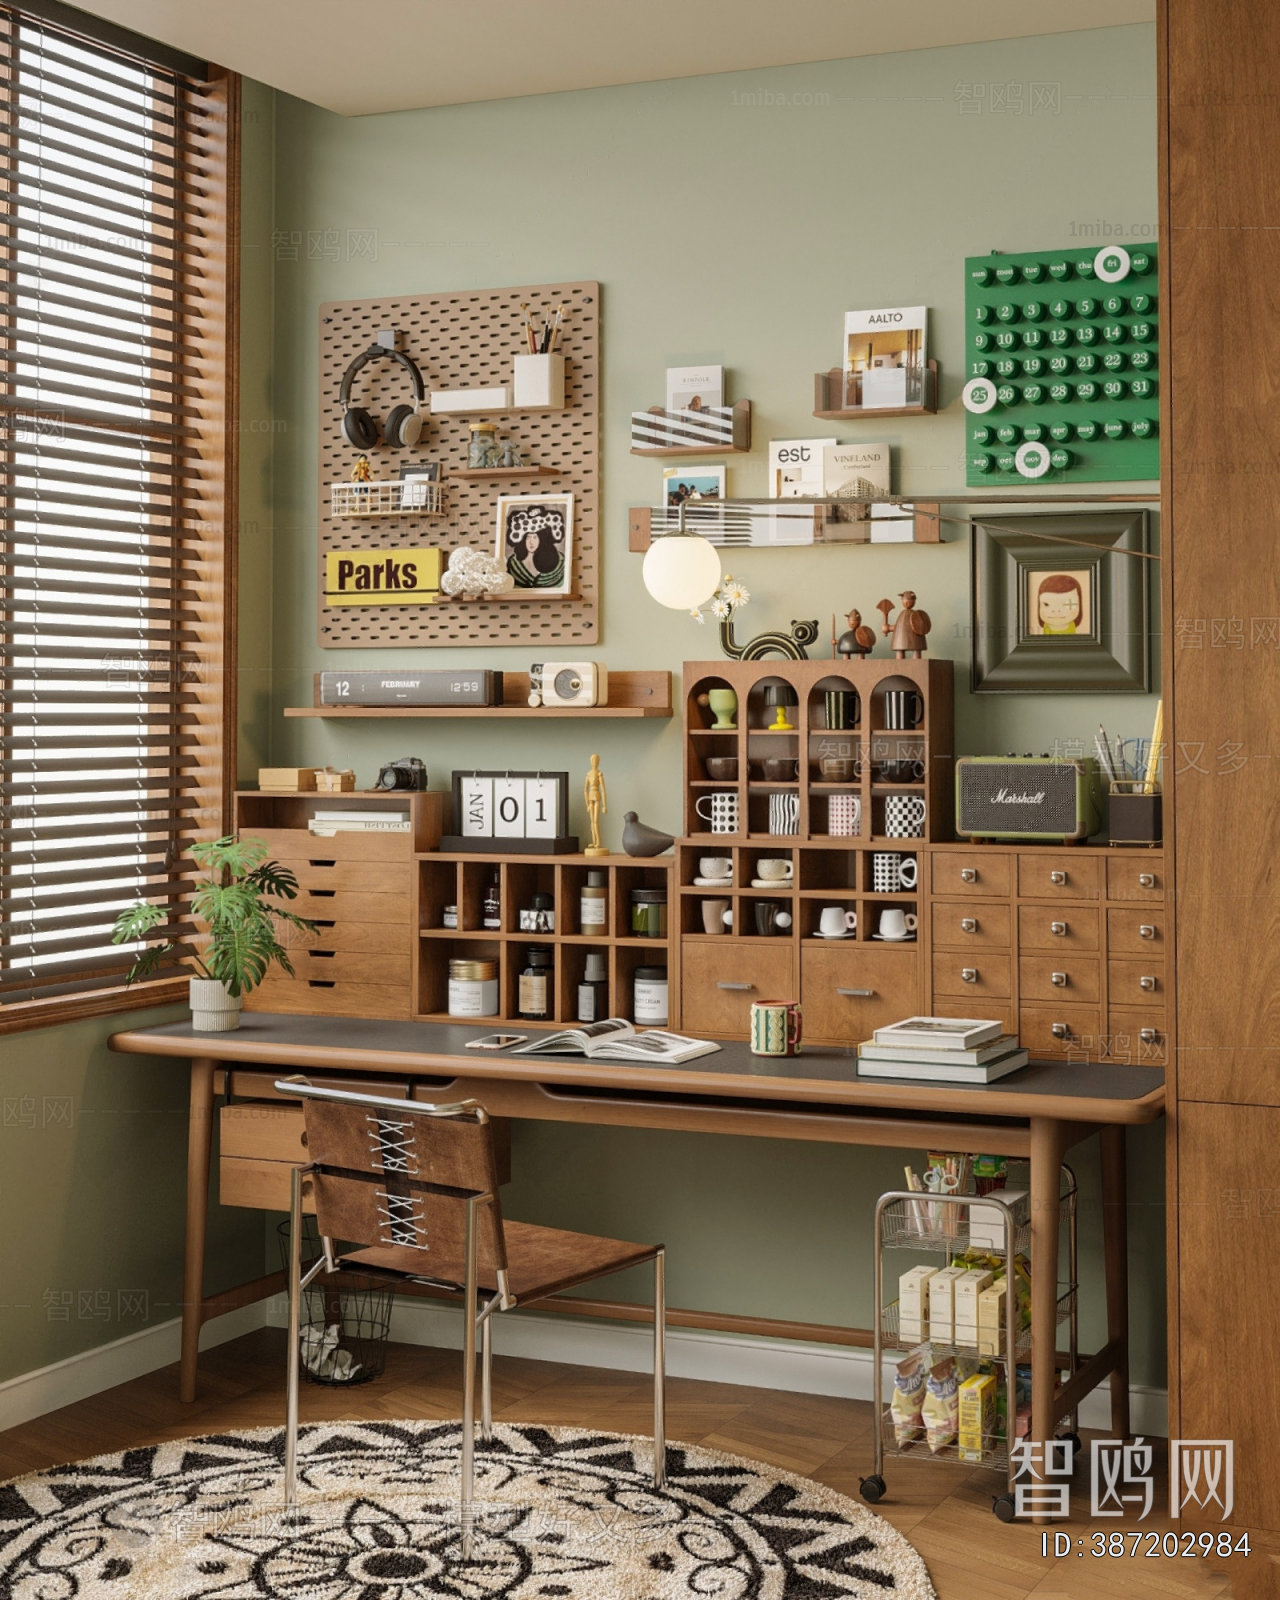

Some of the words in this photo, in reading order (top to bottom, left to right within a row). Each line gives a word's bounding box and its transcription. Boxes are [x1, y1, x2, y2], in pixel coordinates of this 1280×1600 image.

[997, 268, 1013, 276] mon
[1025, 266, 1038, 274] tue
[1051, 263, 1066, 272] wed
[1079, 261, 1092, 269] thu
[1107, 258, 1117, 267] fri
[1133, 257, 1145, 265] sat
[975, 308, 981, 319] 1
[1001, 306, 1009, 317] 2
[1028, 305, 1035, 315] 3
[1055, 303, 1062, 313] 4
[1082, 301, 1089, 311] 5
[1108, 298, 1116, 309] 6
[1136, 297, 1143, 308] 7
[868, 312, 903, 324] AALTO
[975, 336, 983, 346] 9
[999, 333, 1013, 344] 10
[1025, 332, 1039, 342] 11
[1051, 330, 1065, 341] 12
[1079, 328, 1093, 339] 13
[1106, 326, 1120, 337] 14
[1133, 325, 1147, 336] 15
[972, 363, 986, 374] 17
[999, 361, 1013, 372] 18
[1025, 359, 1039, 370] 19
[1052, 358, 1066, 369] 20
[1079, 356, 1093, 367] 21
[1106, 354, 1120, 365] 22
[1133, 352, 1148, 363] 23
[973, 390, 987, 401] 25
[999, 388, 1013, 399] 26
[1025, 387, 1040, 398] 27
[1052, 385, 1066, 396] 28
[1079, 384, 1093, 395] 29
[1106, 382, 1120, 393] 30
[1133, 380, 1148, 391] 31
[974, 430, 986, 439] jan
[1000, 428, 1012, 437] feb
[1052, 426, 1066, 435] apr
[1078, 425, 1094, 434] may
[1105, 423, 1122, 433] june
[1132, 421, 1149, 431] july
[778, 446, 810, 463] est
[834, 454, 881, 463] VINELAND
[1000, 456, 1012, 464] oct
[1052, 453, 1066, 462] dec
[338, 558, 418, 590] Parks
[336, 681, 350, 696] 12
[990, 788, 1046, 804] Marshall
[469, 793, 484, 830] JAN
